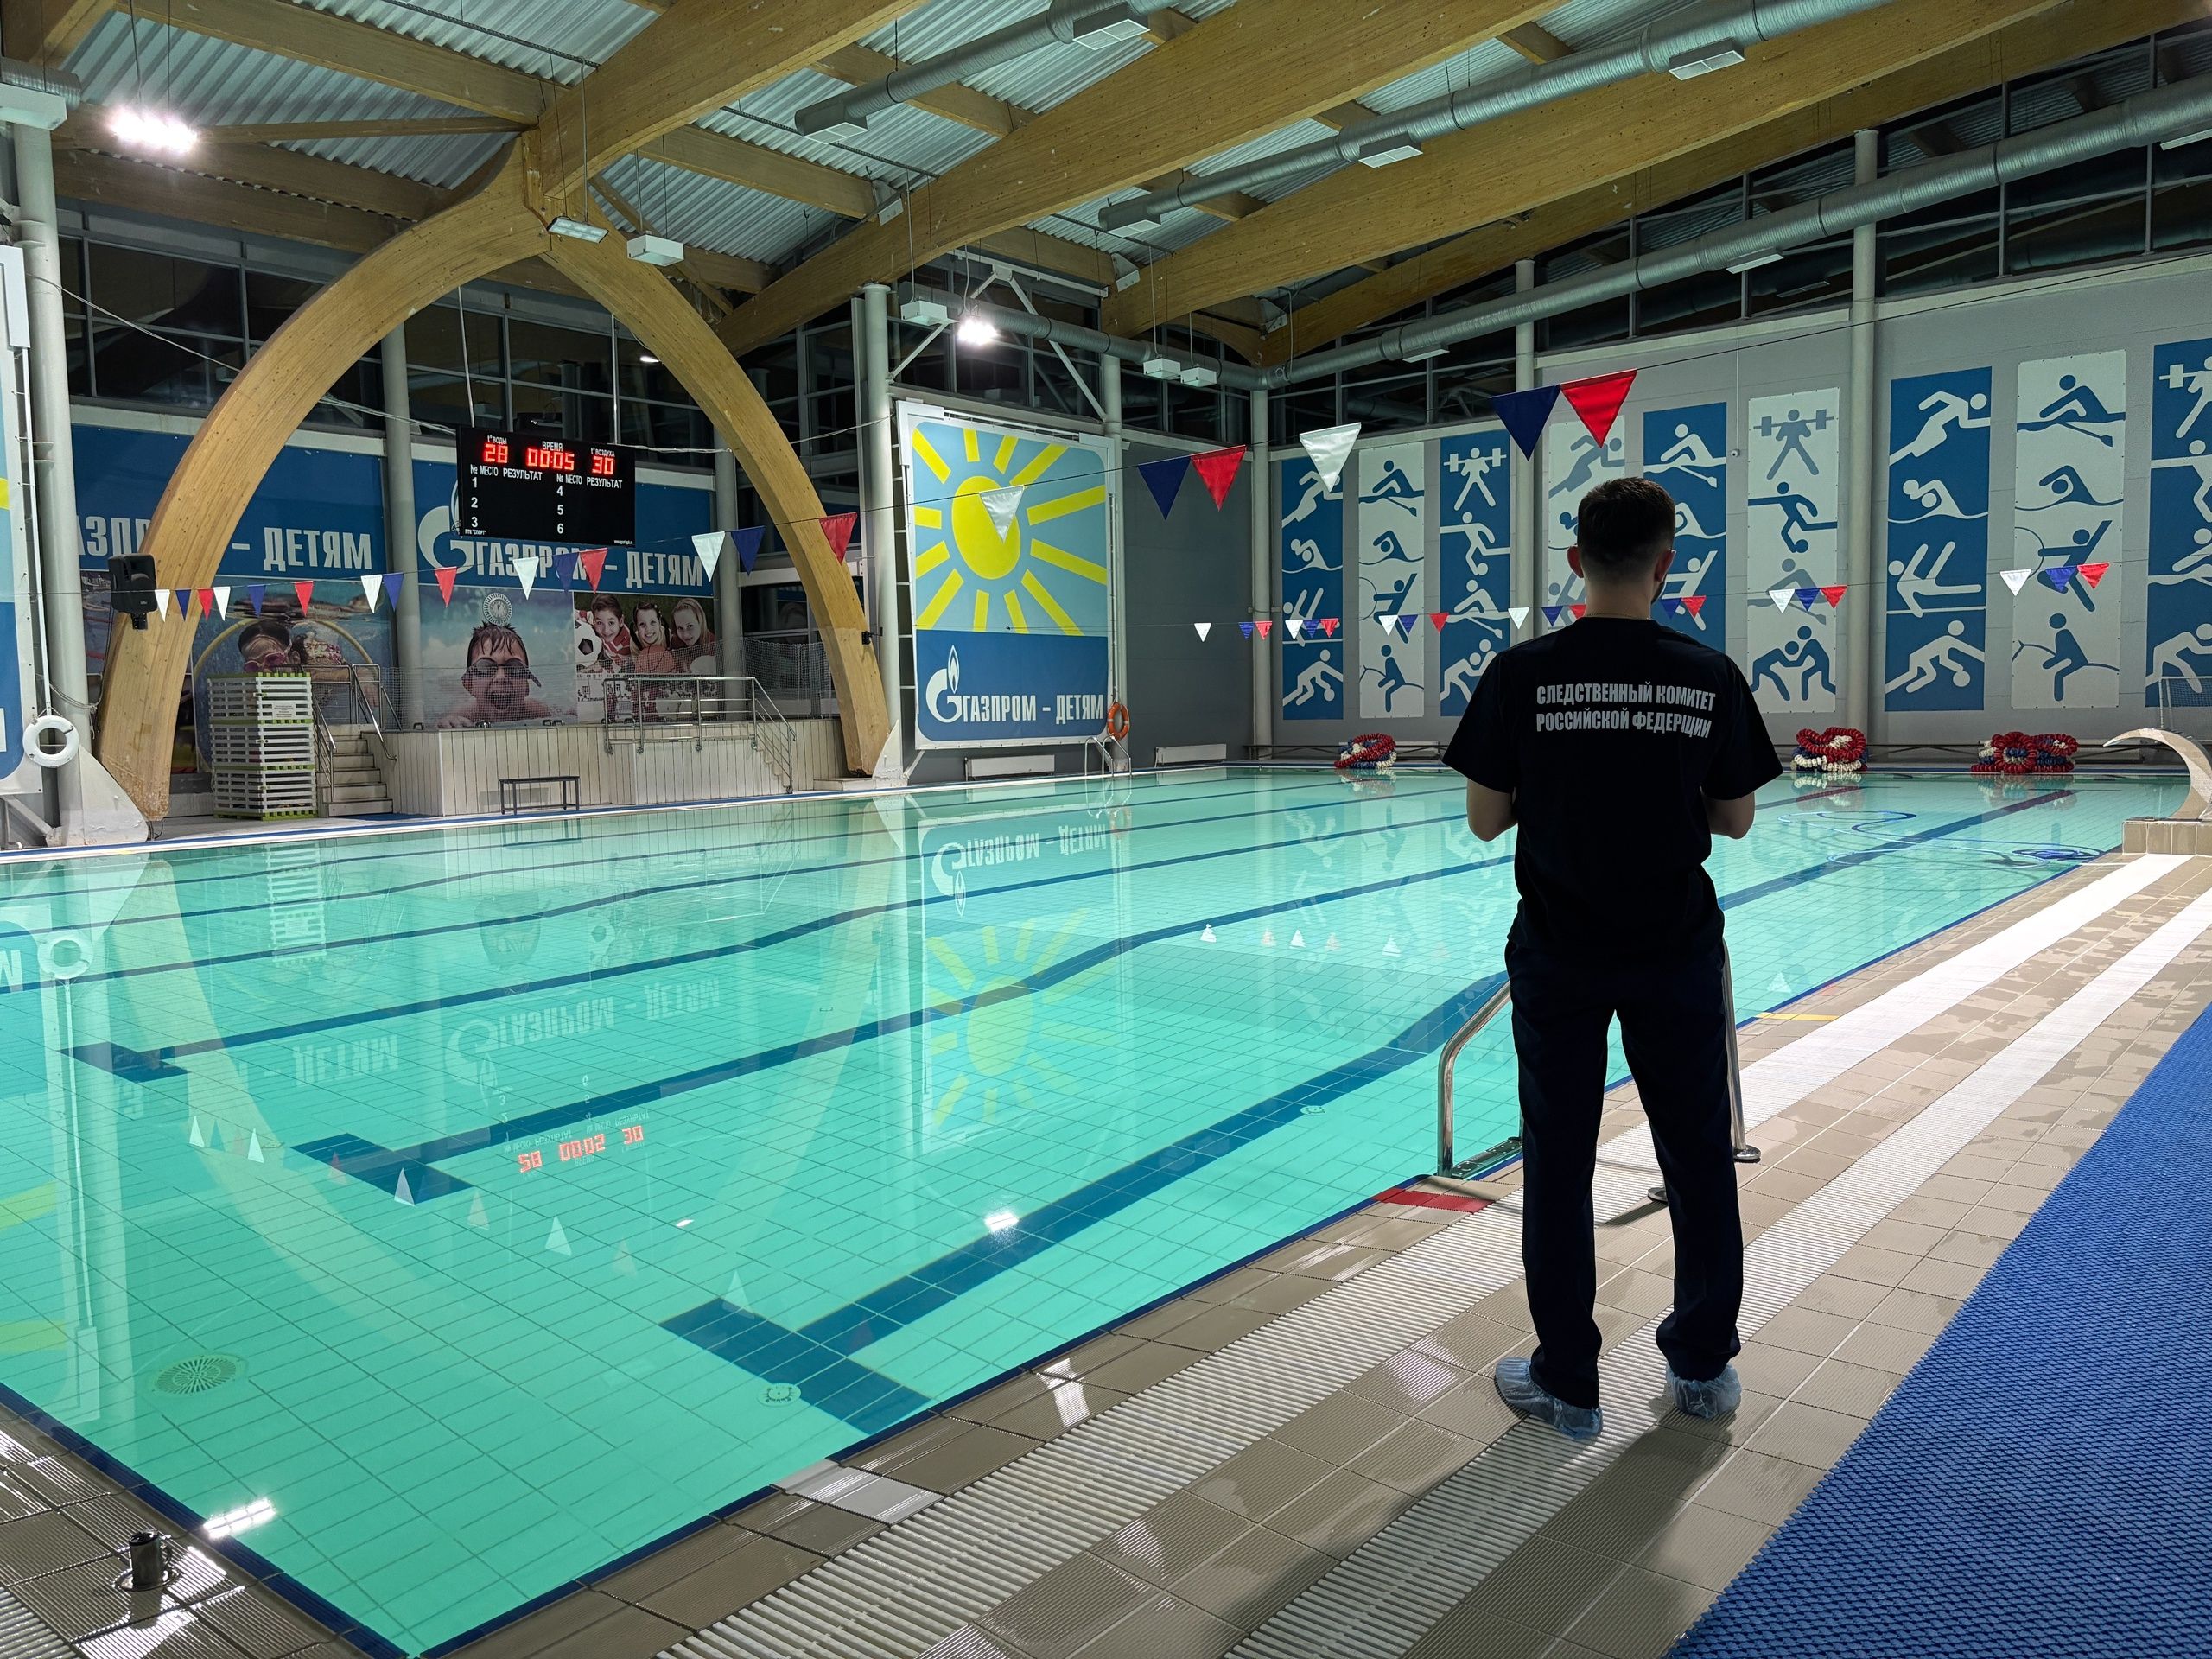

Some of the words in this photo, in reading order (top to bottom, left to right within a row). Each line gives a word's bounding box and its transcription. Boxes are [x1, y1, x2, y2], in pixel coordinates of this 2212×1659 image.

[484, 443, 509, 464] 28
[542, 441, 563, 452] ВРЕМЯ
[526, 448, 575, 471] 00:05
[592, 455, 614, 475] 30
[480, 465, 499, 476] МЕСТО
[503, 467, 543, 481] РЕЗУЛЬТАТ
[472, 476, 478, 488] 1
[565, 474, 582, 485] МЕСТО
[586, 476, 622, 489] РЕЗУЛЬТАТ
[556, 485, 564, 497] 4
[471, 496, 479, 509] 2
[557, 504, 564, 516] 5
[471, 516, 479, 528] 3
[556, 523, 564, 534] 6
[263, 527, 372, 572] ДЕТЯМ
[626, 550, 703, 589] ДЕТЯМ
[1536, 681, 1653, 706] СЛЕДСТВЕННЫЙ
[1656, 685, 1716, 712] КОМИТЕТ
[963, 695, 1037, 723] ГАЗПРОМ
[1055, 694, 1104, 725] ДЕТЯМ
[1535, 707, 1630, 732] РОССИЙСКОЙ
